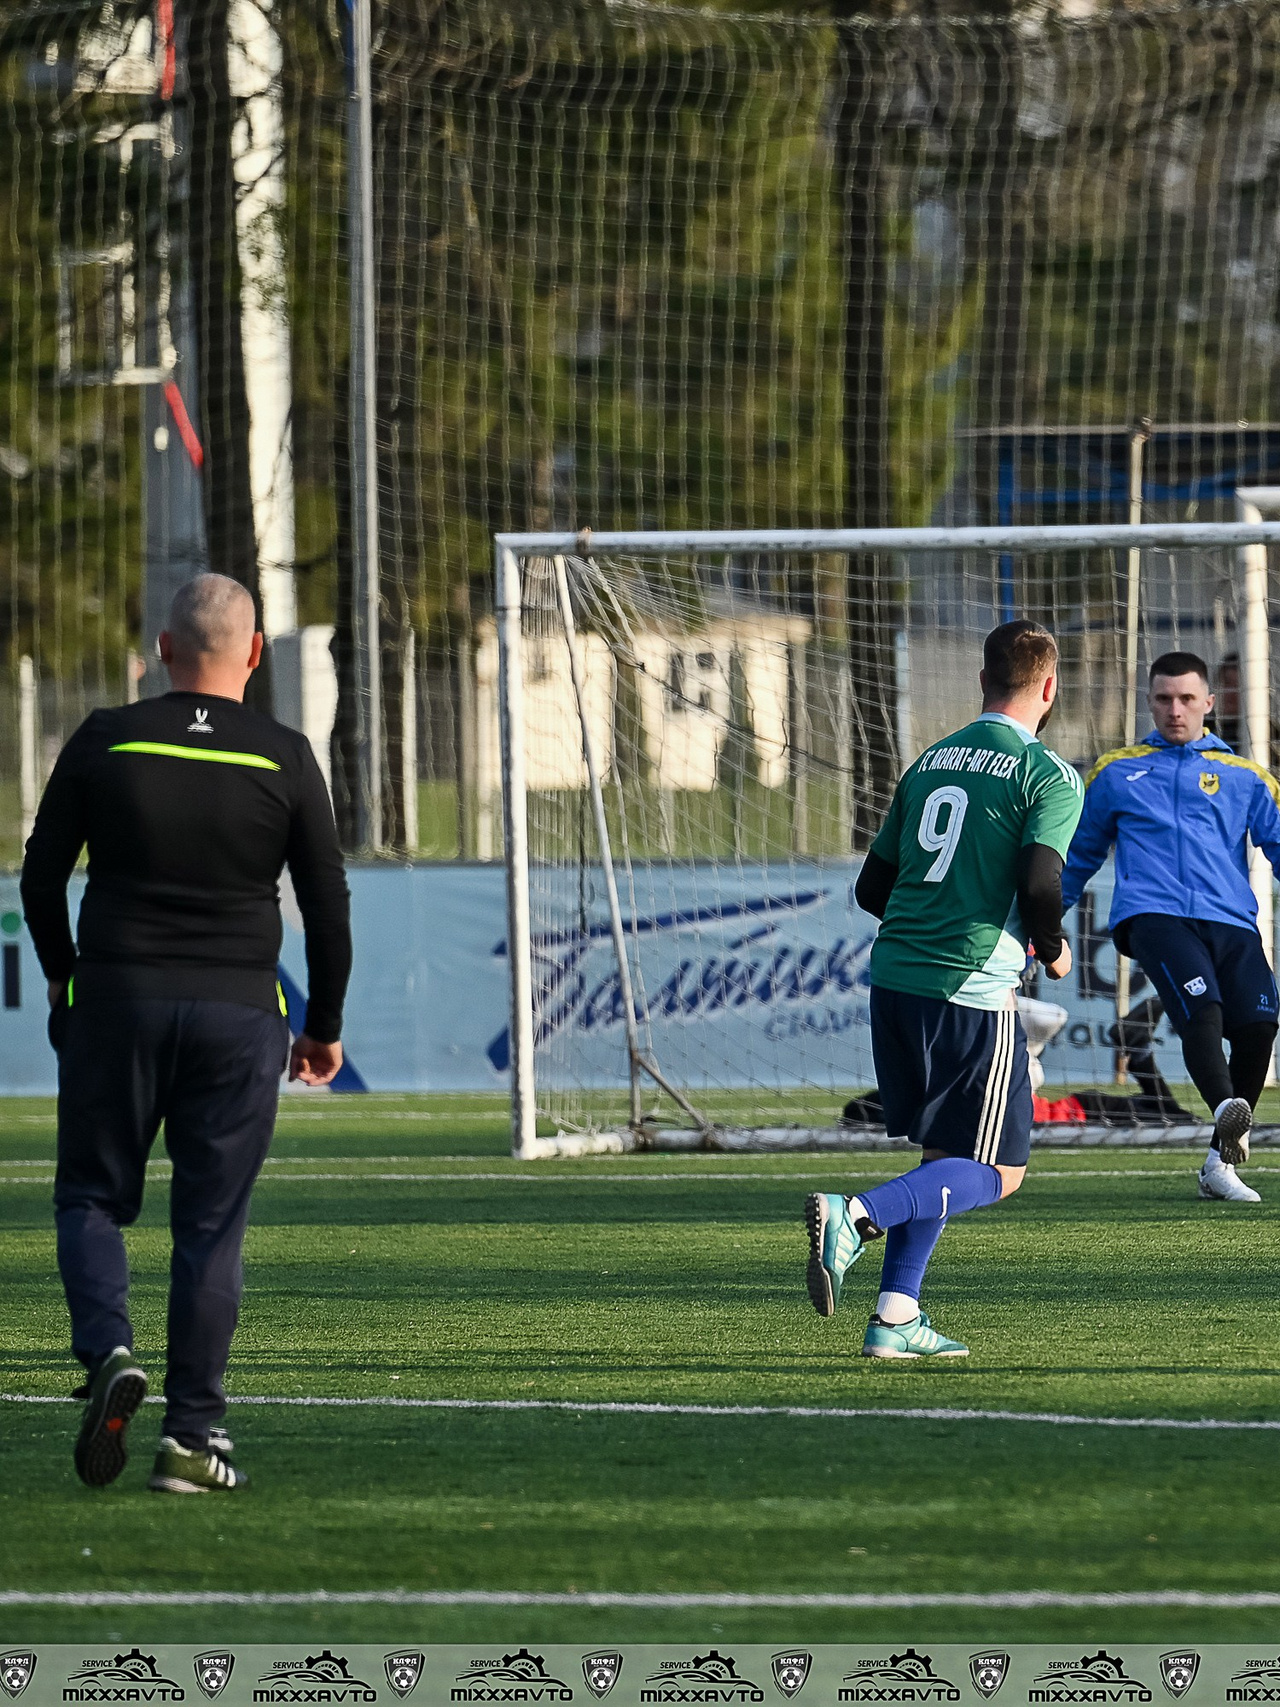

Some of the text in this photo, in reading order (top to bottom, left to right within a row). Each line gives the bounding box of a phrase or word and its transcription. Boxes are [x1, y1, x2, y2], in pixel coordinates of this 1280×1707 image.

[917, 747, 1022, 780] FC ARARAT-ART FLEX
[917, 785, 969, 883] 9
[486, 888, 872, 1071] Балтик
